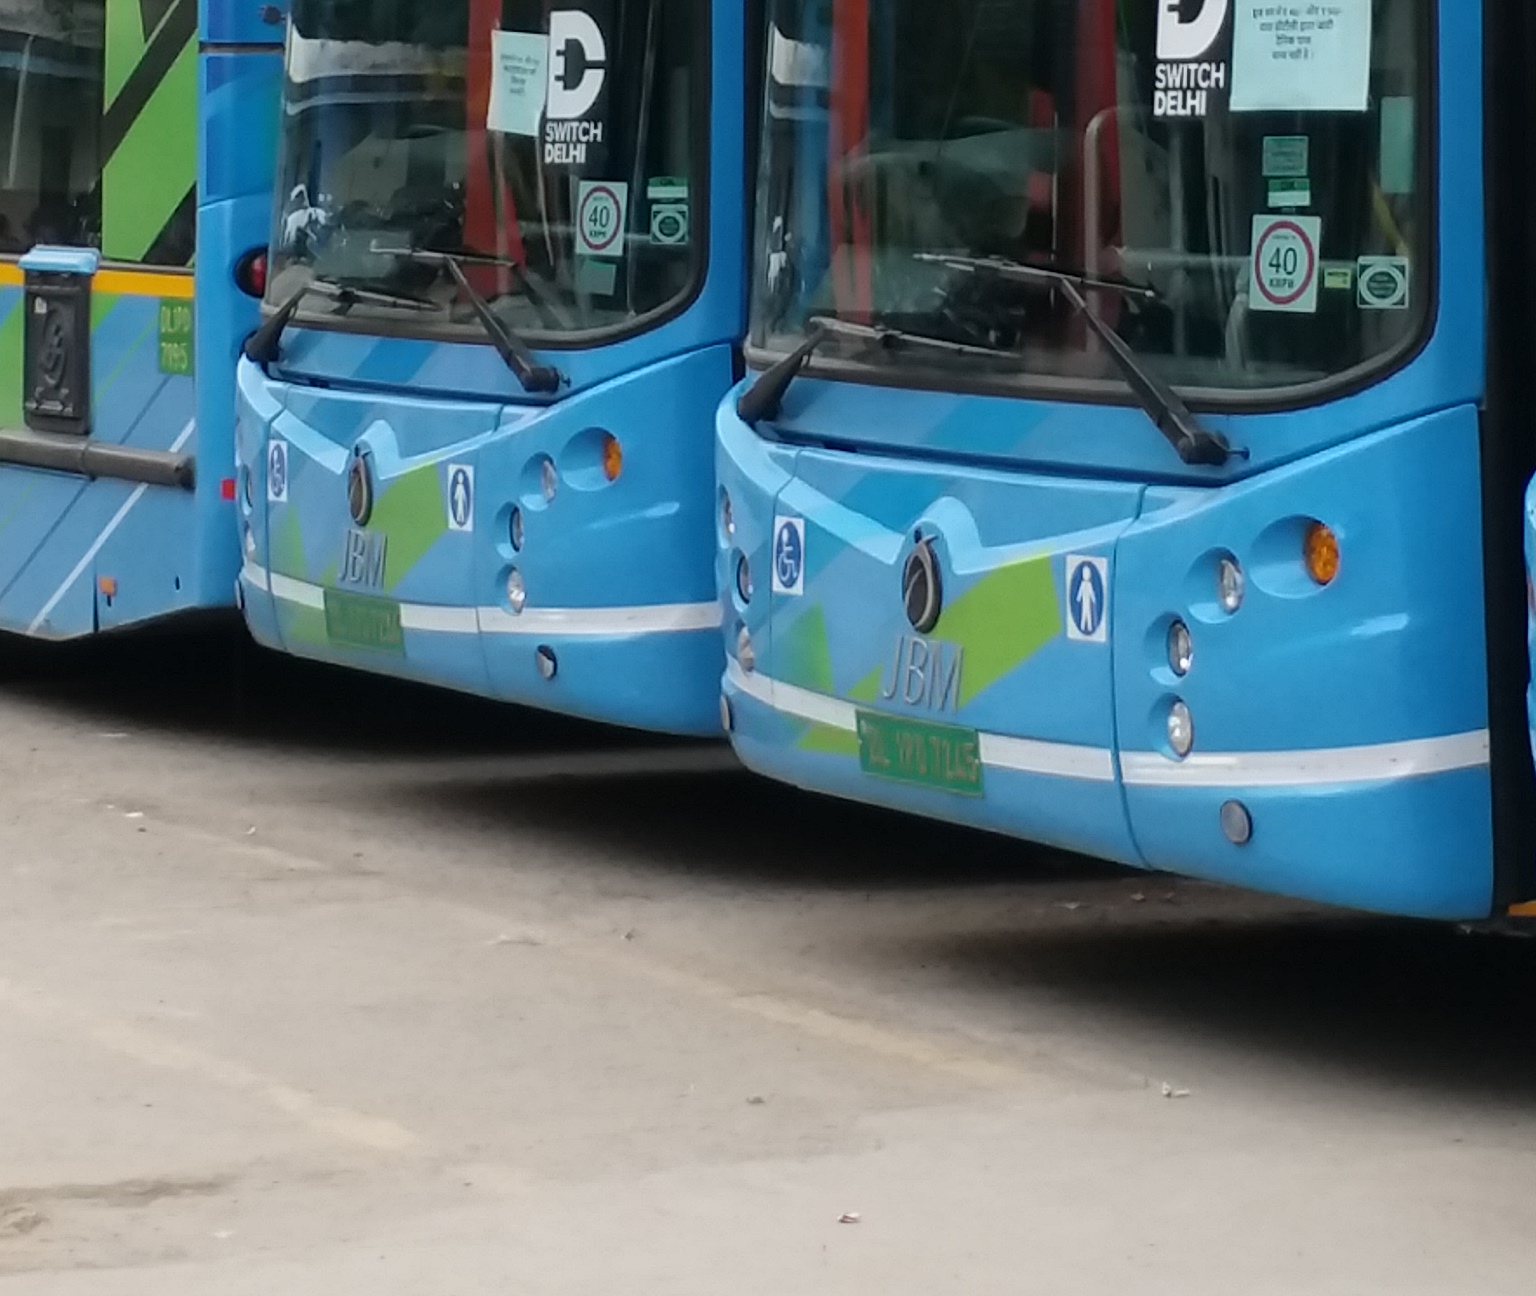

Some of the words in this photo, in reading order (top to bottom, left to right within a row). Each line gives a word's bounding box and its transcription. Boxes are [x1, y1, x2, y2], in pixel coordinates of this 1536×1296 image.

[1155, 61, 1226, 90] SWITCH
[1153, 90, 1207, 116] DELHI
[544, 121, 602, 142] SWITCH
[544, 143, 586, 164] DELHI
[588, 205, 611, 228] 40
[1268, 246, 1298, 276] 40
[339, 529, 388, 589] JBM
[883, 635, 964, 712] JBM
